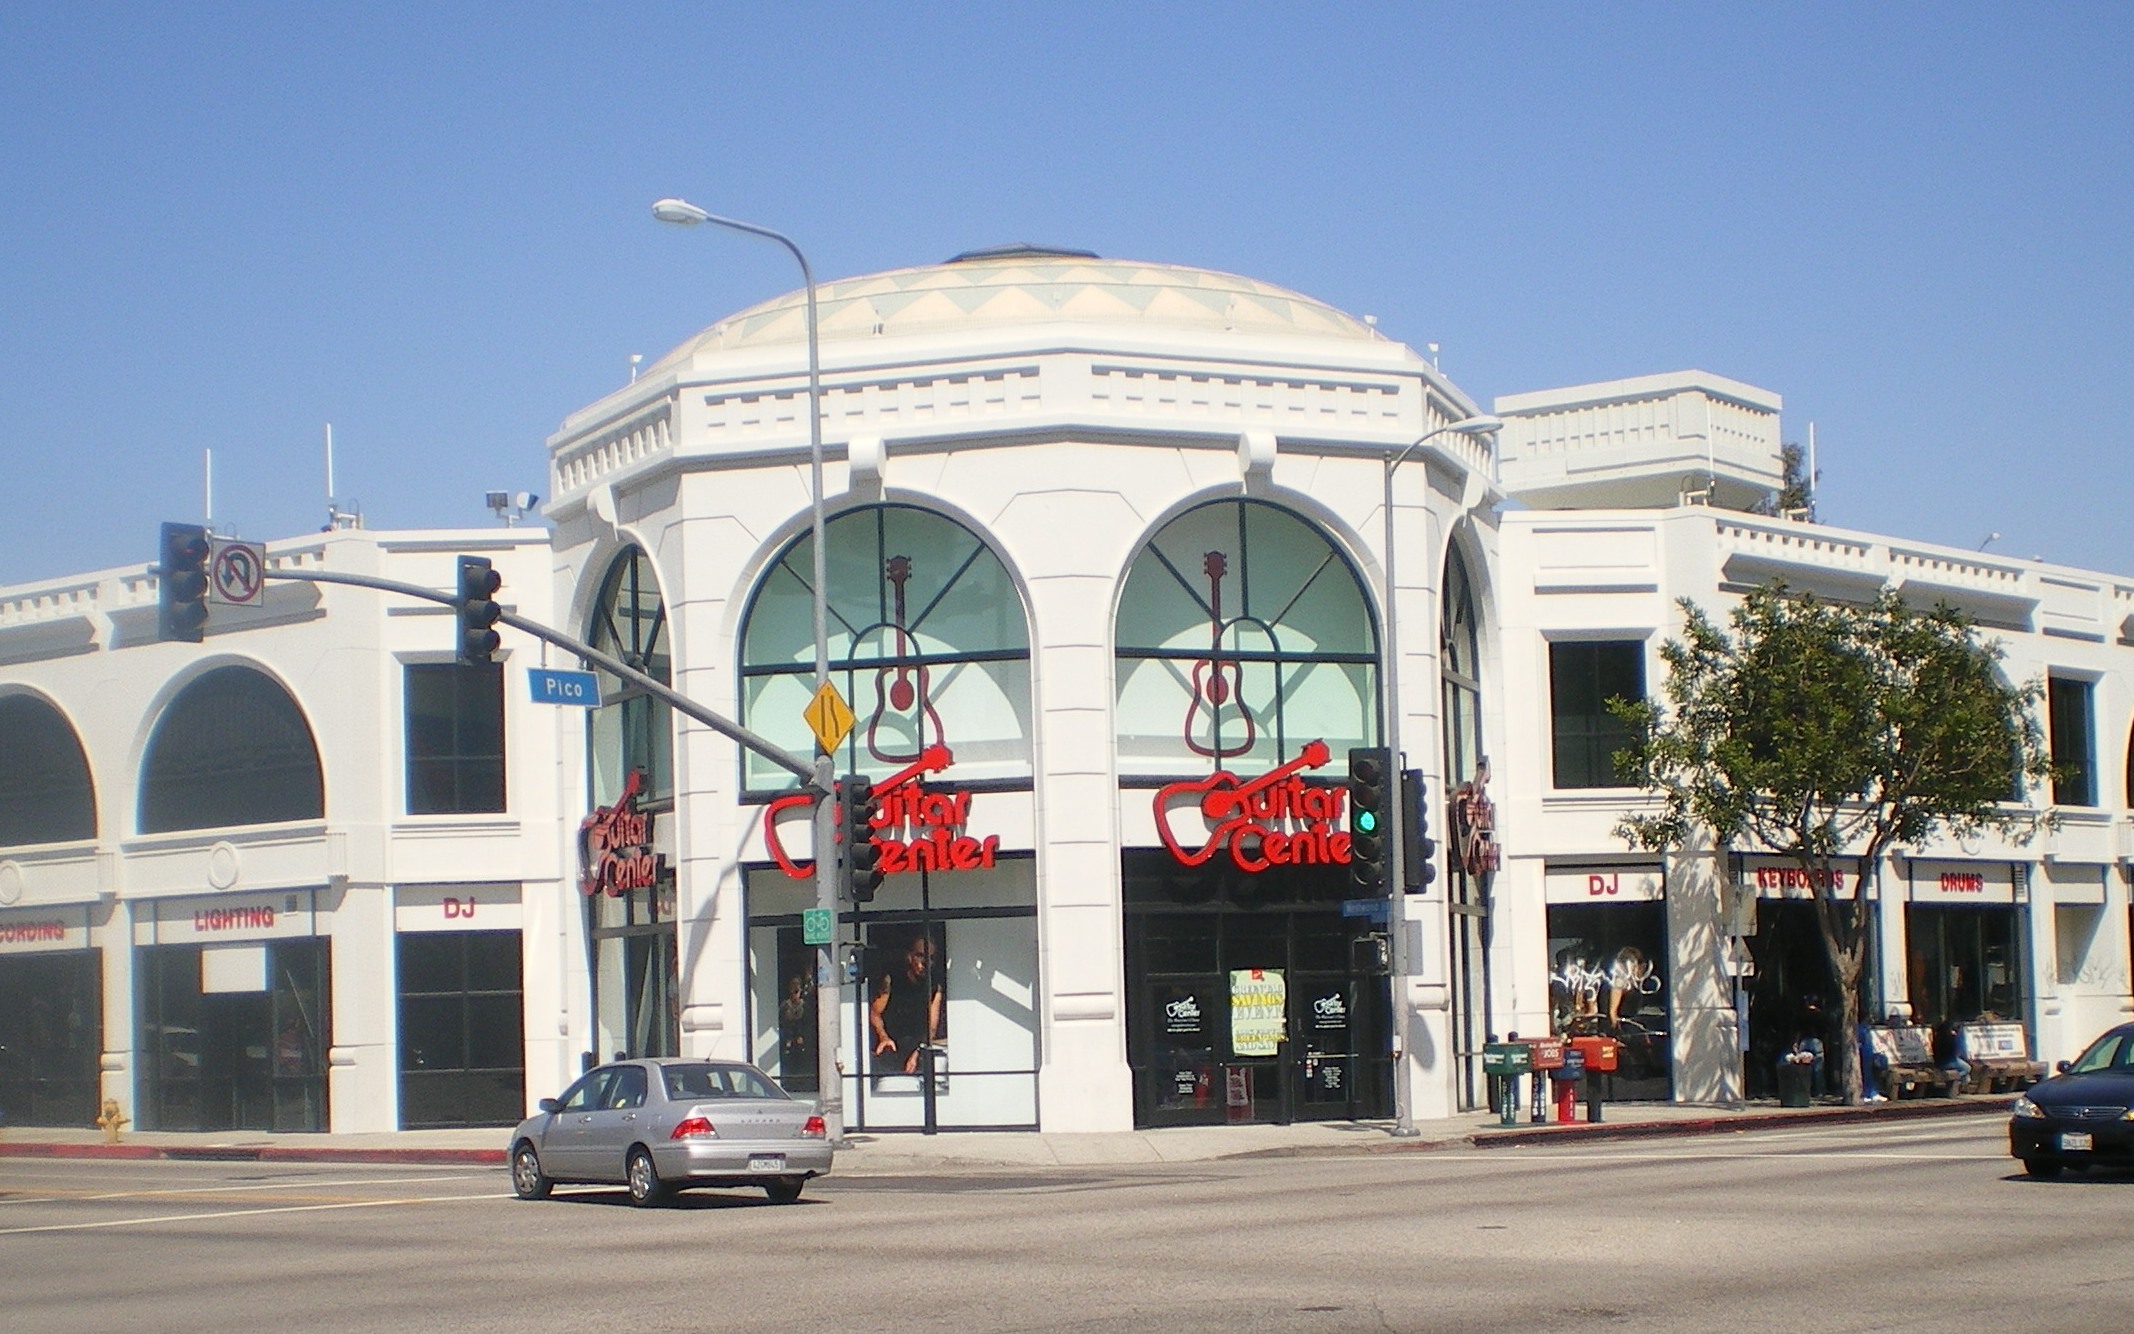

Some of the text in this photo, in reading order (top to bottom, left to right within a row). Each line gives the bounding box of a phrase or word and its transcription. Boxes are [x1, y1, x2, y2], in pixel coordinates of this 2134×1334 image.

[545, 677, 583, 697] Pico
[868, 828, 999, 873] enter
[1228, 818, 1352, 873] Cente
[604, 848, 660, 897] Center
[1589, 872, 1619, 896] DJ
[1757, 867, 1844, 890] KEYBORS
[1941, 872, 1983, 892] DRUMS
[194, 906, 274, 931] LIGHTING
[443, 896, 475, 919] DJ
